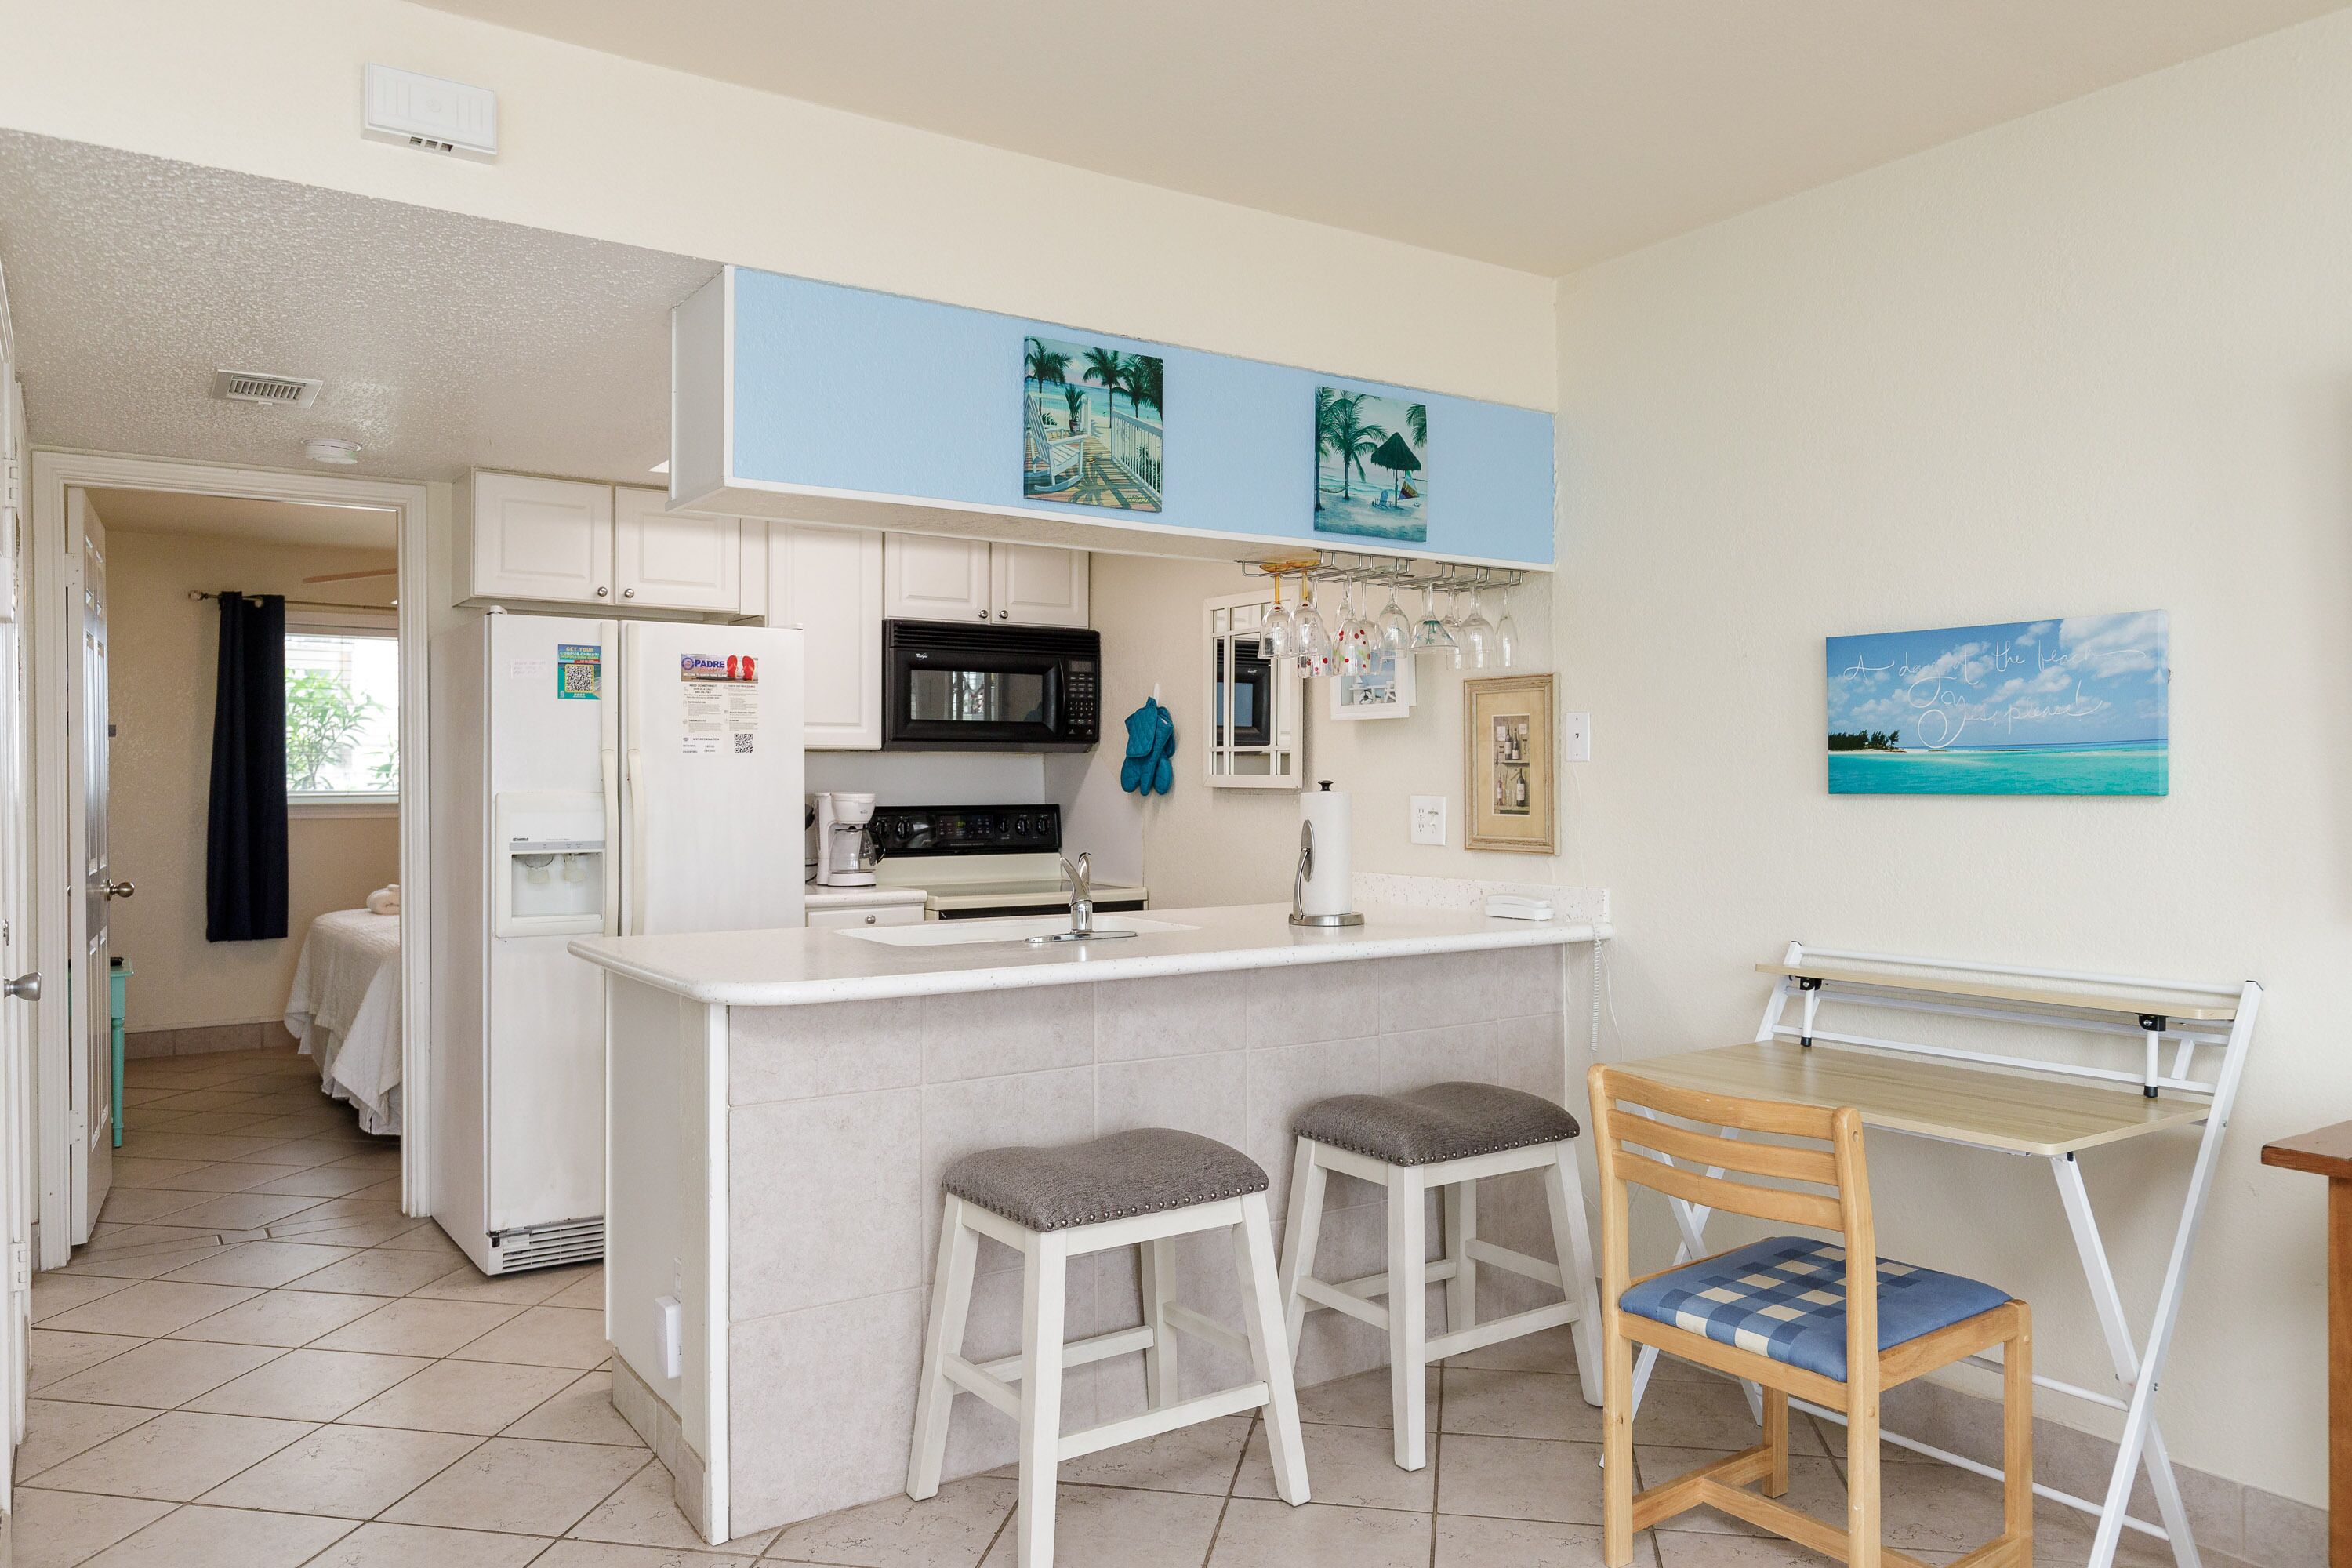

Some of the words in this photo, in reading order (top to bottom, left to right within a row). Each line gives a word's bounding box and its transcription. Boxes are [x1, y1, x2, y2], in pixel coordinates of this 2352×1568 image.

[695, 659, 726, 669] PADRE
[1843, 654, 1896, 681] A
[1898, 652, 1957, 709] day
[1992, 640, 2026, 672] the
[2038, 639, 2147, 672] beach
